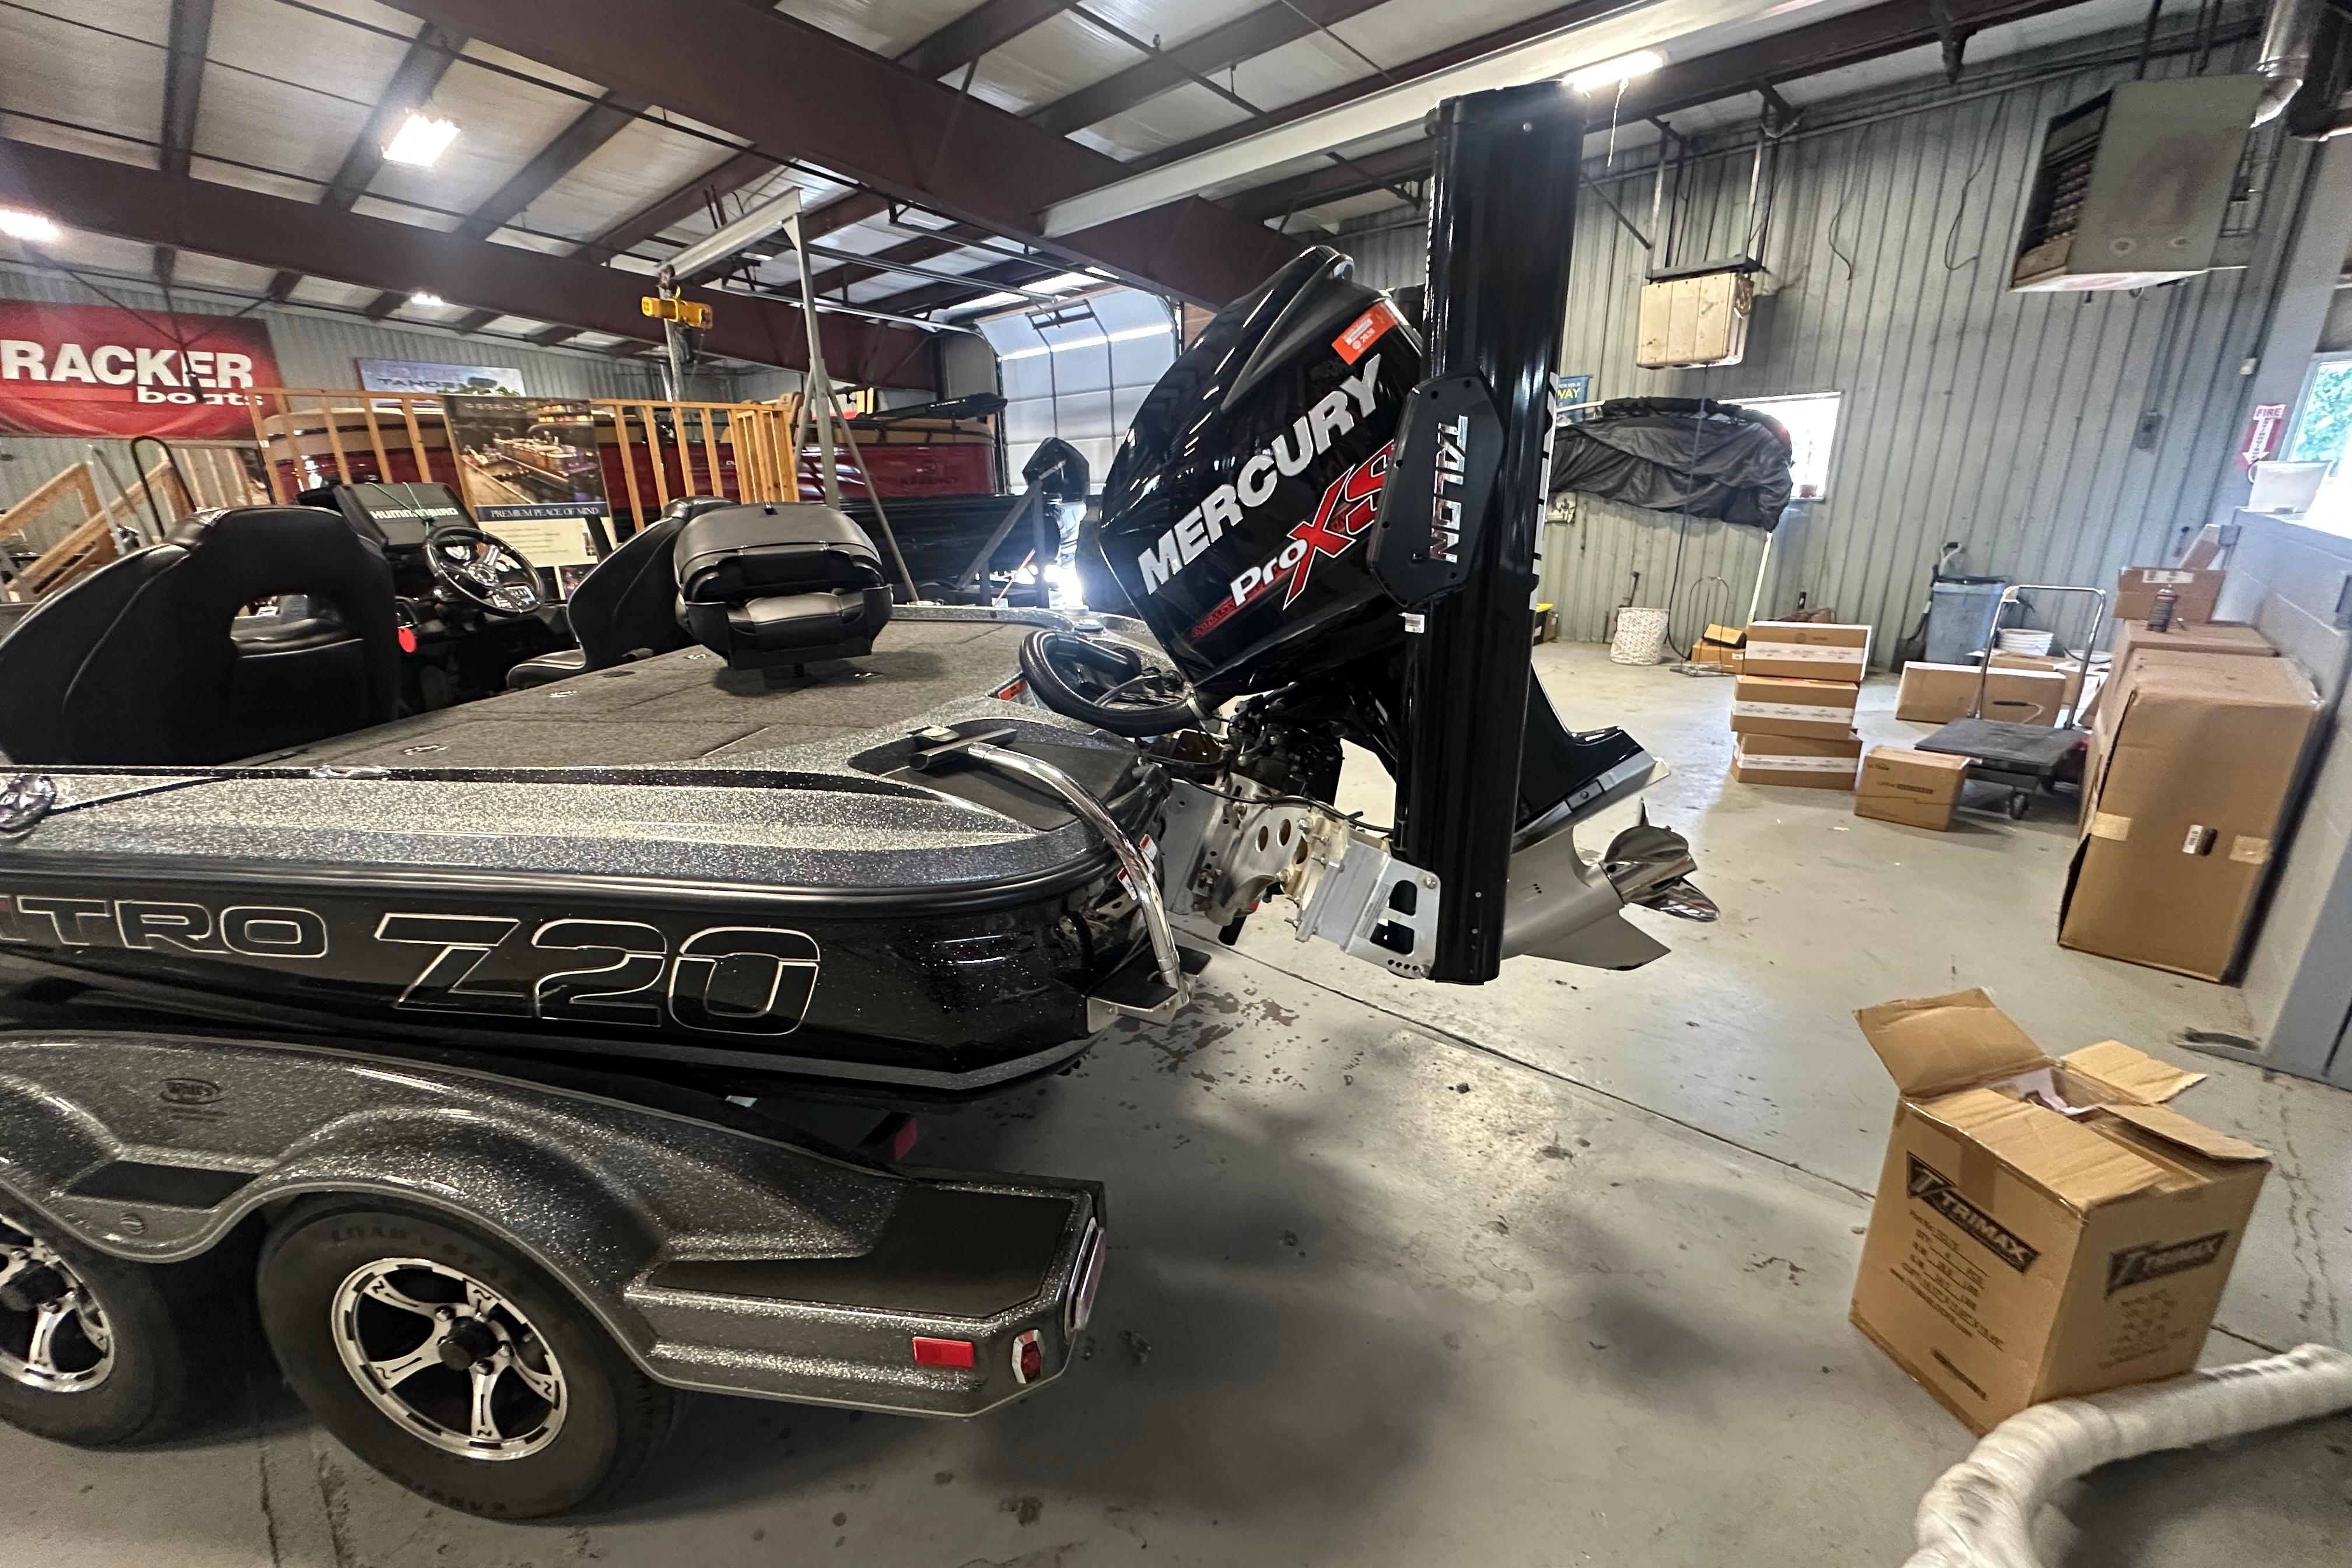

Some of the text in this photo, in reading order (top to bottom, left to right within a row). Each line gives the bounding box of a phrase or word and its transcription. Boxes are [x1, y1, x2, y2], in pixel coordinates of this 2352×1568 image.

[0, 340, 254, 389] RACKER
[2256, 408, 2282, 416] FIRE
[1138, 354, 1381, 594] MERCURY
[1430, 415, 1468, 564] TALON
[369, 507, 459, 519] HUMMINBIRD
[491, 506, 598, 518] PREMIUM PEACE OF MIND
[374, 912, 821, 1036] Z20
[1941, 1192, 2031, 1264] TRIMAX
